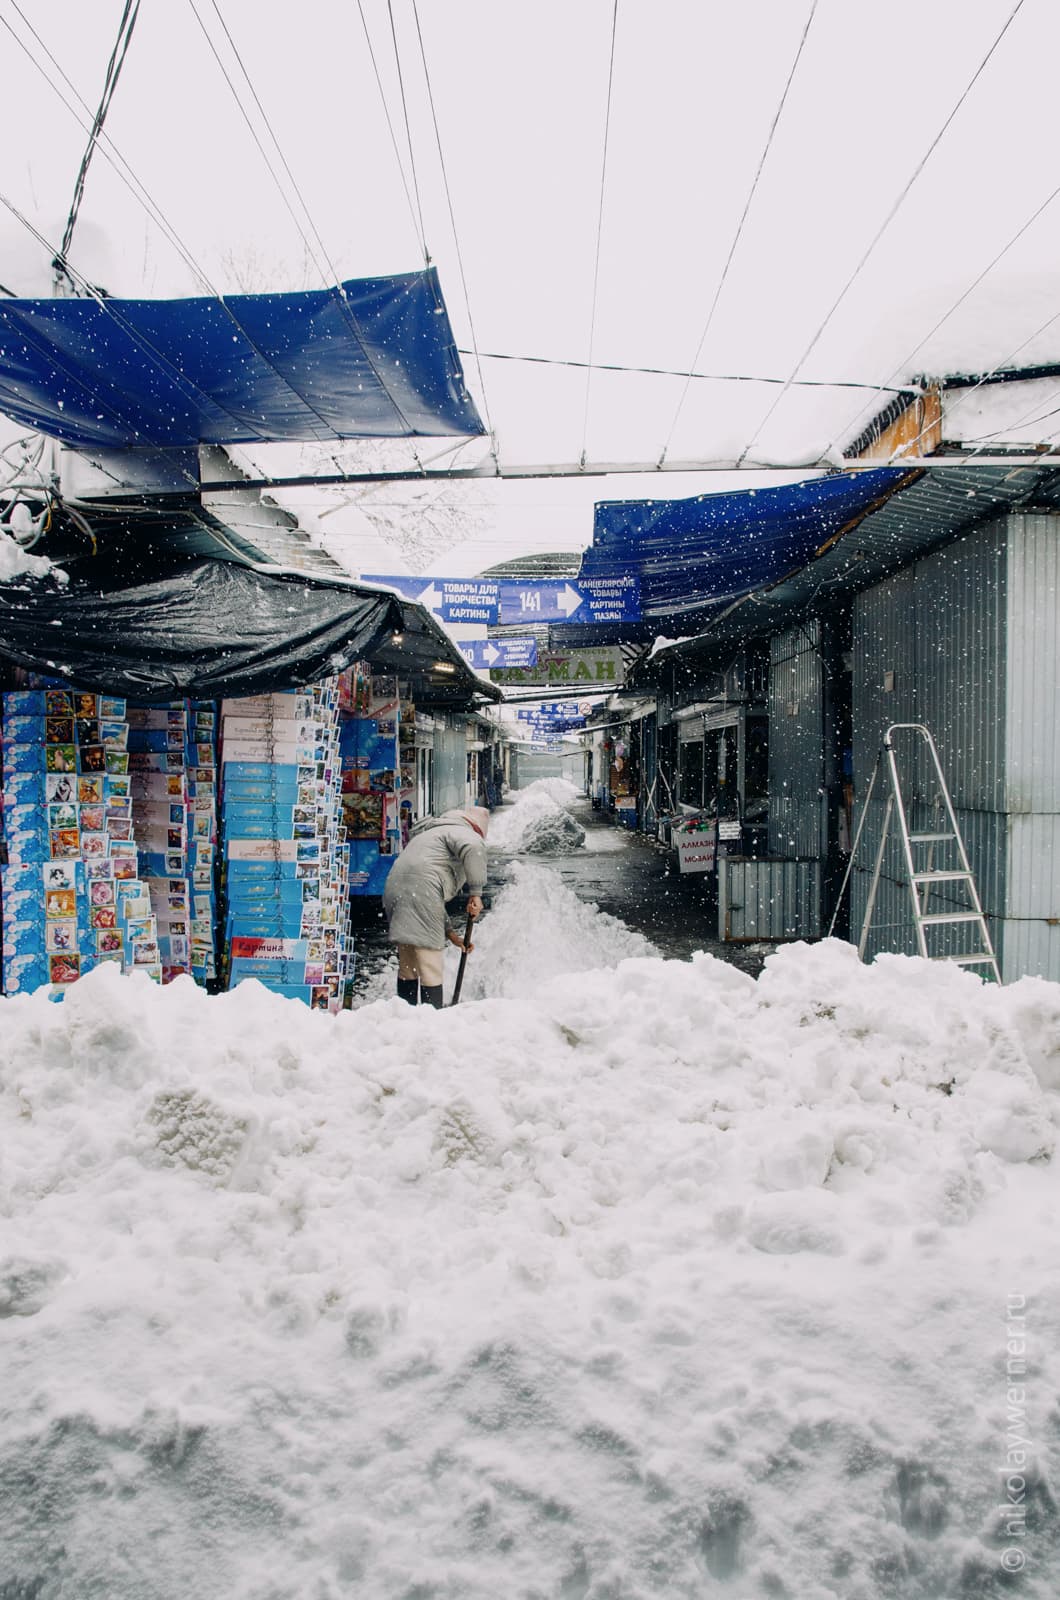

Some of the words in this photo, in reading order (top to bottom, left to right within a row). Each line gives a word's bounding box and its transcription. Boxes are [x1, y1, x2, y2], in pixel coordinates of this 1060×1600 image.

[443, 583, 478, 593] ТОВАРЫ
[479, 584, 498, 595] ДЛЯ
[578, 579, 636, 589] КАНЦЕЛЯРСКИЕ
[593, 588, 622, 598] ТОВАРЫ
[444, 594, 497, 605] ТВОРЧЕСТВА
[520, 591, 540, 611] 141
[590, 600, 625, 609] КАРТИНЫ
[449, 607, 490, 619] КАРТИНЫ
[593, 611, 622, 620] ПАЗЛЫ
